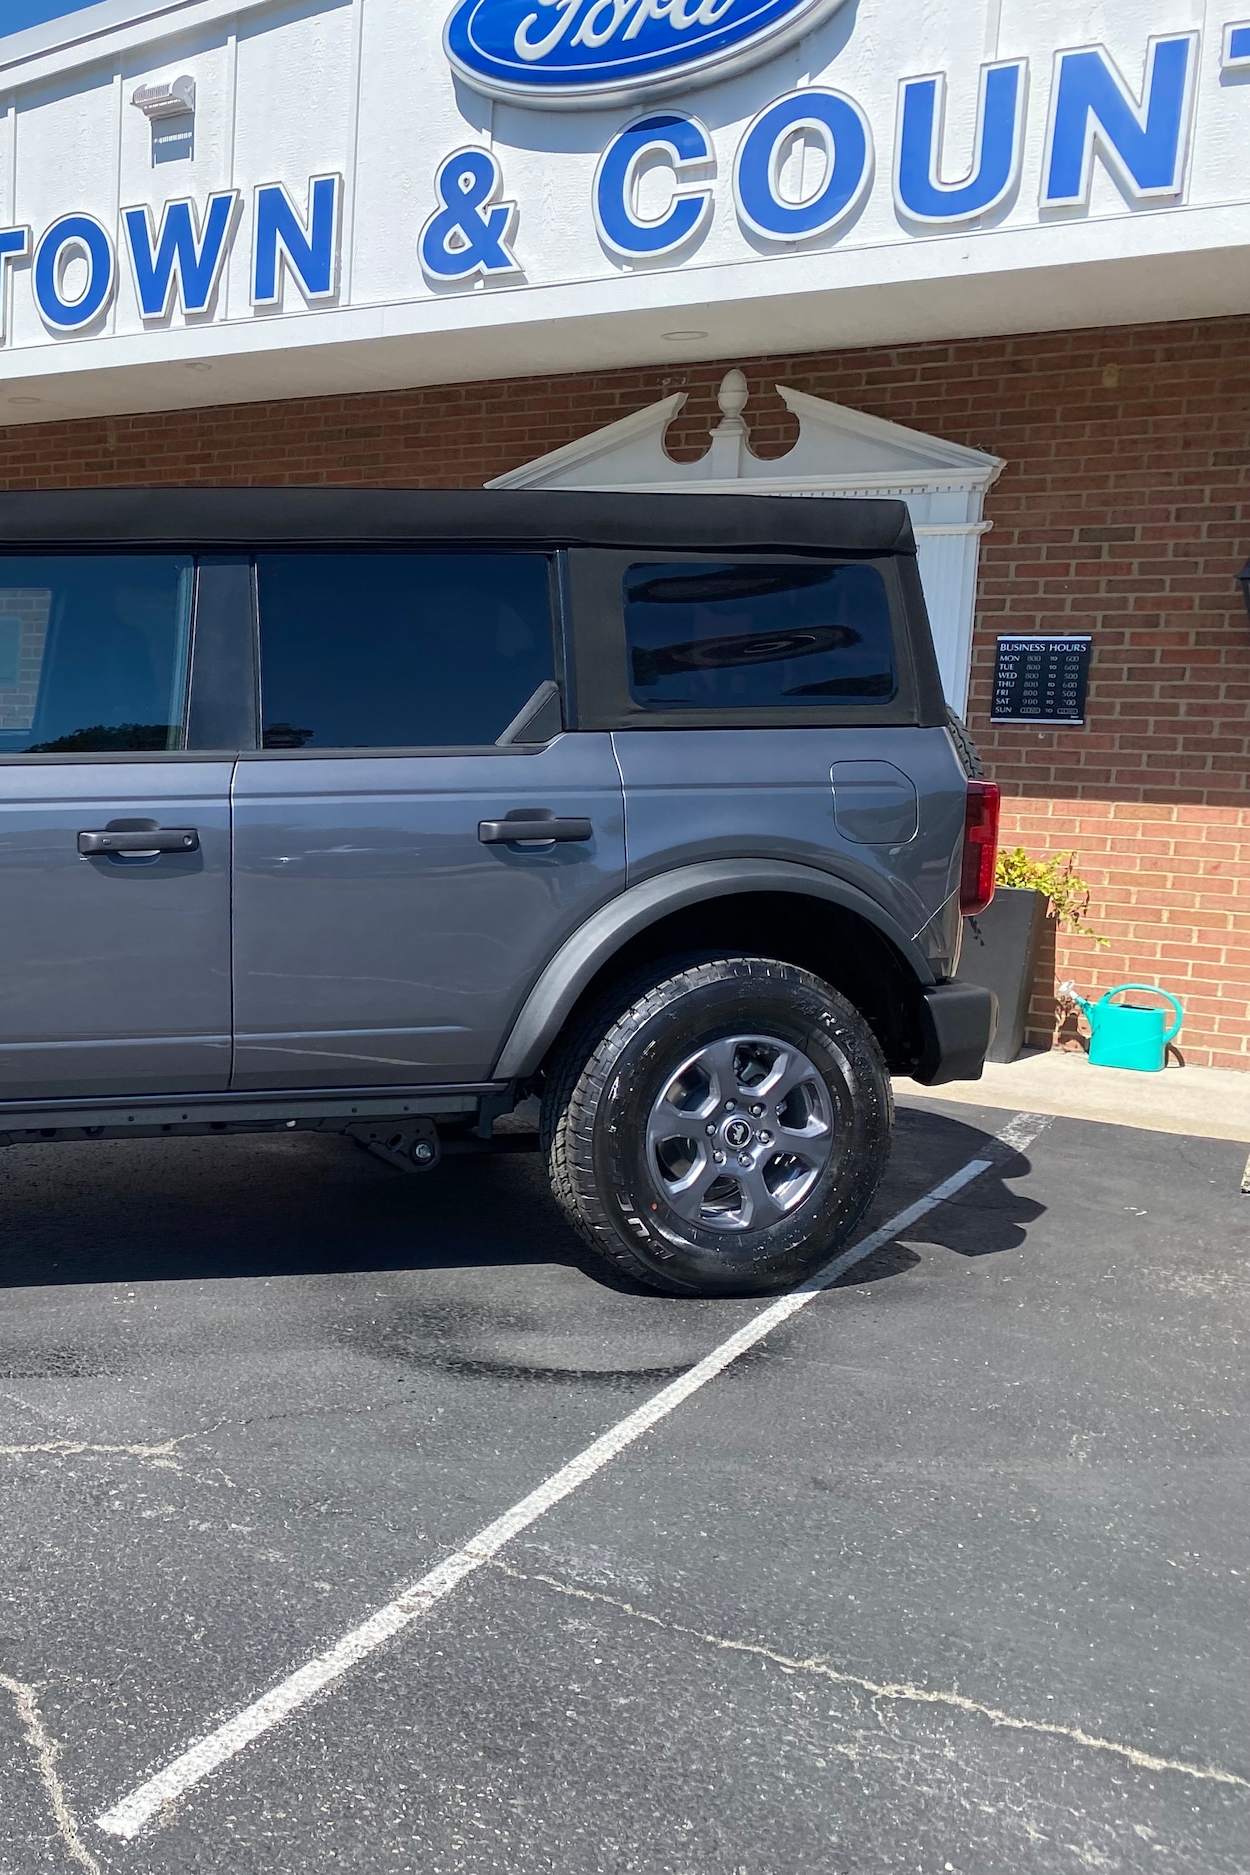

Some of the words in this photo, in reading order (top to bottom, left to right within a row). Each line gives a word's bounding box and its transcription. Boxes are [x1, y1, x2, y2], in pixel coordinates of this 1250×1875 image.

[418, 145, 525, 282] &
[593, 22, 1250, 259] COUN
[1000, 643, 1045, 652] BUSINESS
[1049, 643, 1087, 652] HOURS
